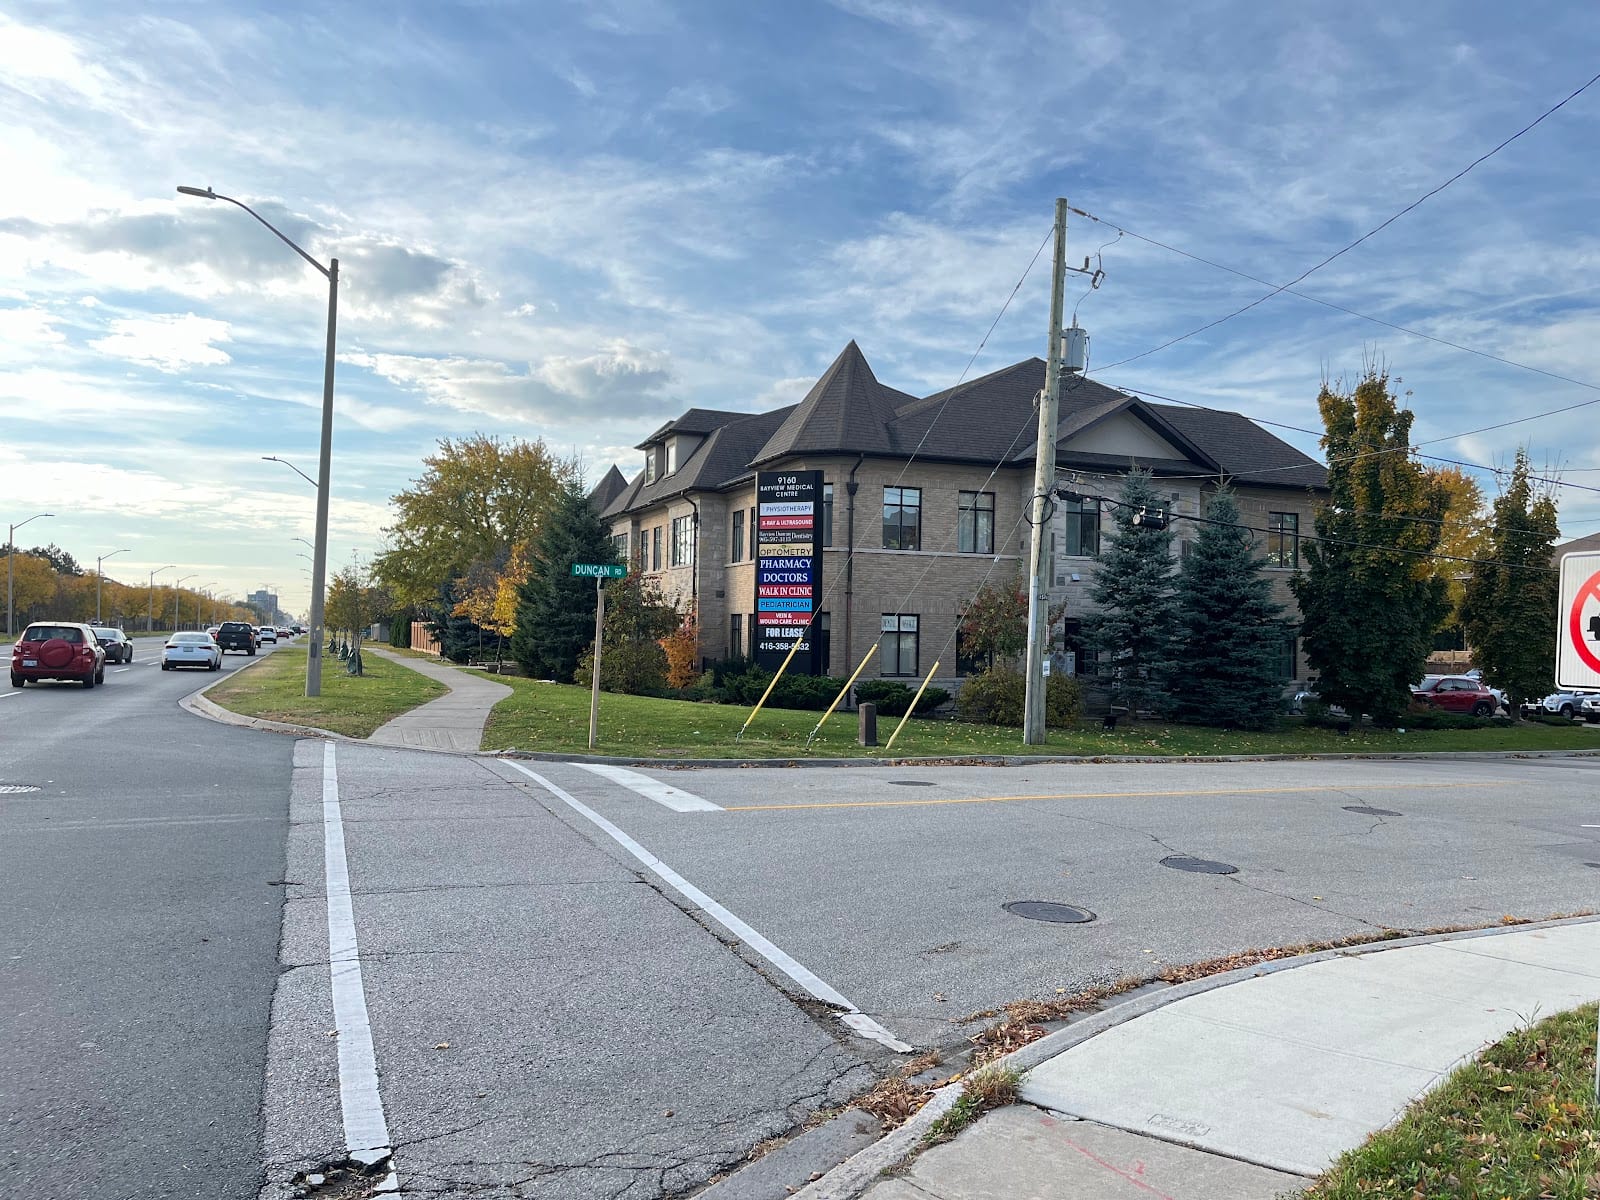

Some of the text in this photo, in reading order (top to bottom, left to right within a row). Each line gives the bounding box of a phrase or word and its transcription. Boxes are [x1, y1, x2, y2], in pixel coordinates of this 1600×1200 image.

[777, 476, 797, 485] 9160
[765, 505, 812, 513] PHYSIOTHERAPY
[791, 532, 813, 540] Dentistry
[760, 548, 811, 556] OPTOMETRY
[760, 559, 812, 569] PHARMACY
[575, 564, 610, 576] DUNCAN
[763, 573, 808, 583] DOCTORS
[759, 586, 812, 596] WALK IN CLINIC
[765, 627, 804, 638] FOR LEASE
